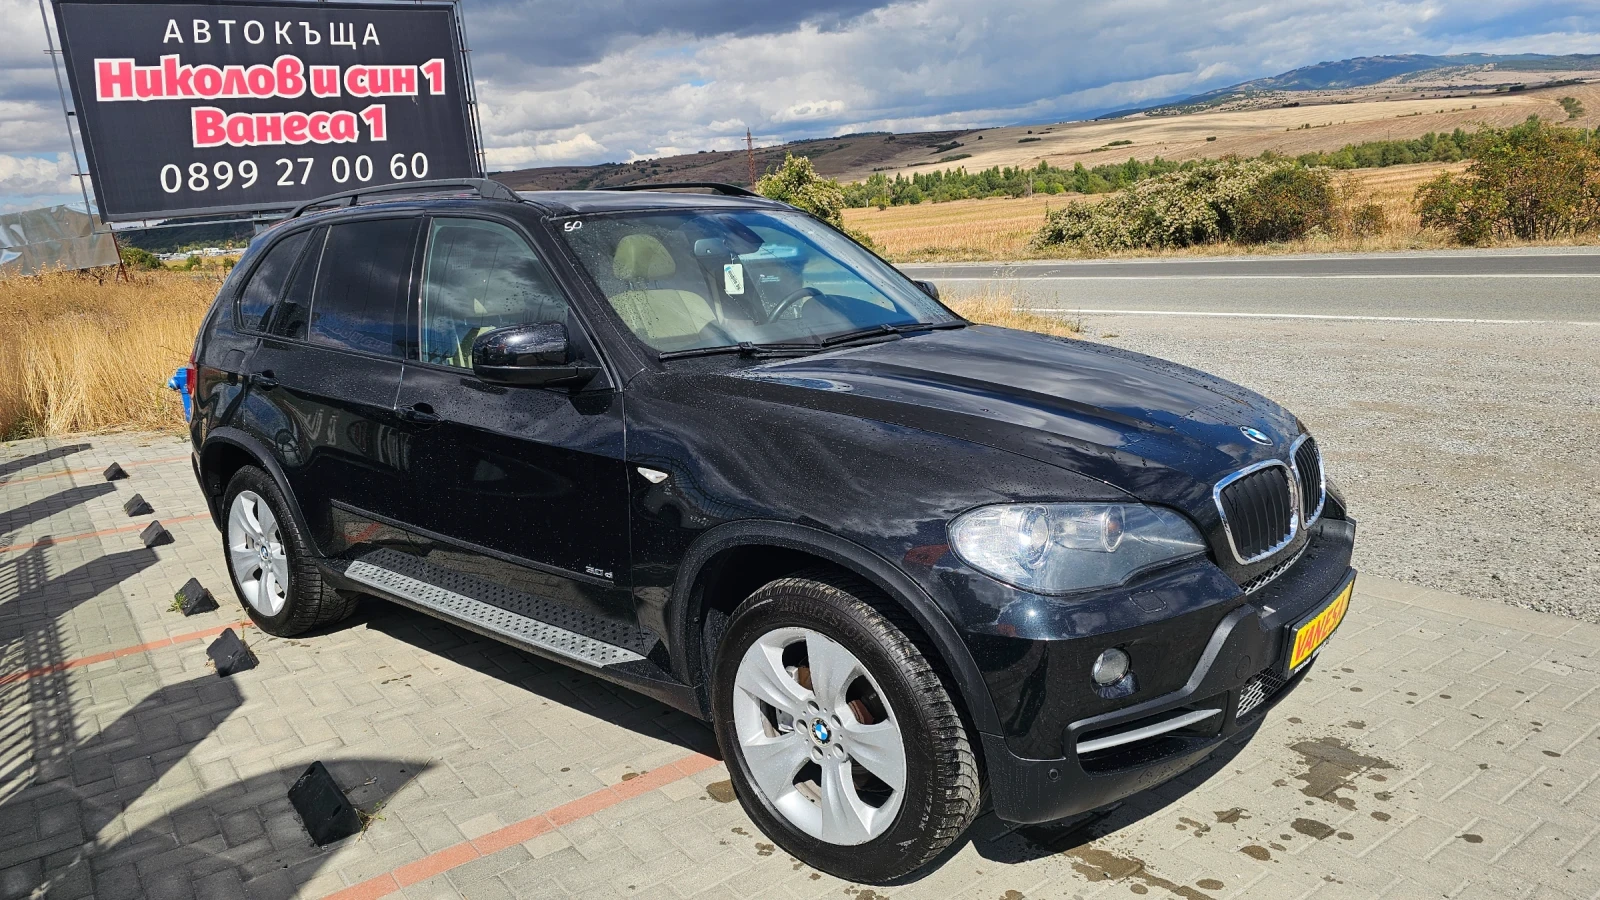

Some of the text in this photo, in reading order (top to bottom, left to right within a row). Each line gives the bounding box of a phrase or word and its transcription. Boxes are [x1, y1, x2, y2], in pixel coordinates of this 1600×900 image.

[163, 19, 380, 50] АВТОКЪЩА
[94, 54, 446, 101] Николов и син 1
[191, 104, 387, 148] Ванеса 1
[160, 152, 428, 193] 0899 27 00 60
